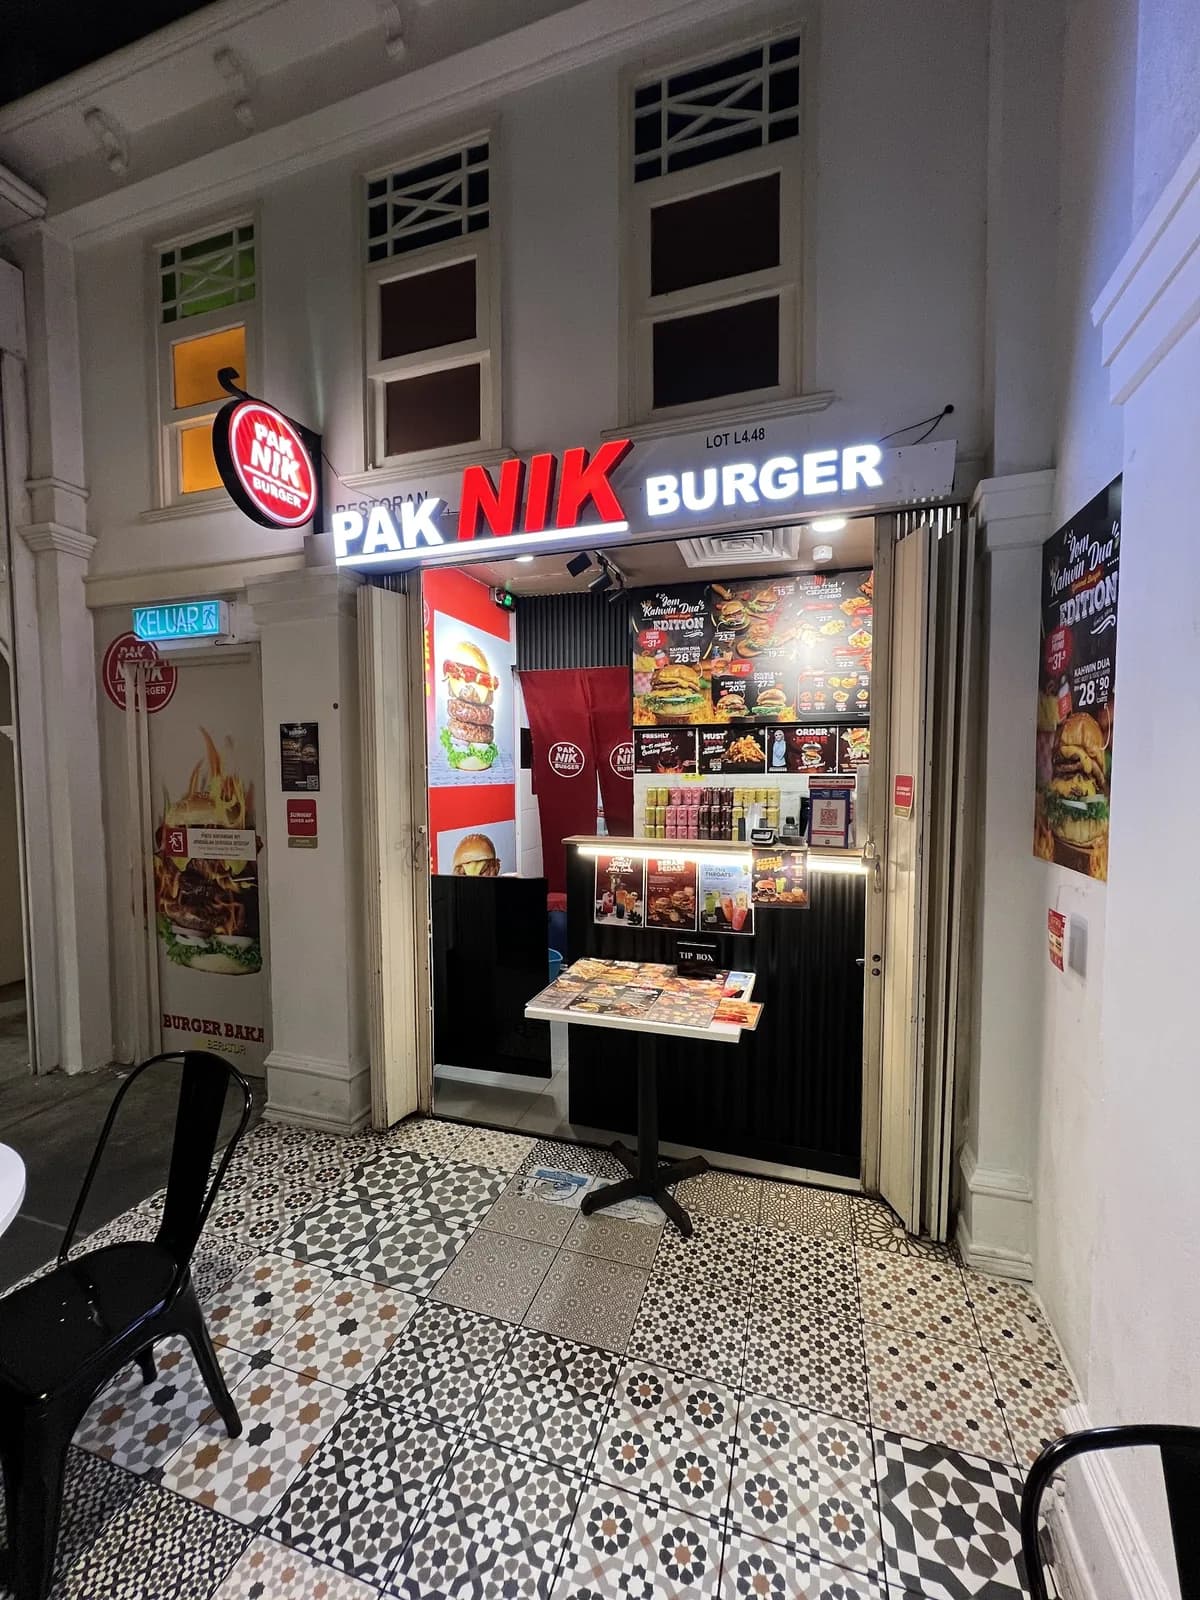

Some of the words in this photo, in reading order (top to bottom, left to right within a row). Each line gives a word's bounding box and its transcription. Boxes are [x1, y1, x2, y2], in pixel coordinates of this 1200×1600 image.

[254, 421, 295, 460] PAK
[706, 433, 730, 449] LOT
[734, 427, 765, 444] L4.48
[251, 439, 300, 489] NIK
[252, 476, 302, 508] BURGER
[332, 498, 444, 557] PAK
[457, 439, 635, 541] NIK
[645, 443, 884, 516] BURGER
[1050, 558, 1085, 598] Kahwin
[1059, 570, 1119, 626] EDITION
[135, 606, 200, 636] KELUAR
[642, 603, 677, 617] Kahwin
[653, 617, 704, 632] EDITION
[115, 660, 164, 682] NK
[1074, 661, 1097, 677] KAHWIN
[1097, 657, 1111, 670] DUA
[117, 683, 167, 696] URGER
[703, 732, 725, 740] MUST
[795, 728, 828, 736] ORDER
[555, 752, 578, 763] NIK
[557, 746, 575, 754] PAK
[679, 951, 693, 960] TIP
[696, 953, 714, 962] BOX
[163, 1014, 222, 1037] BURGER
